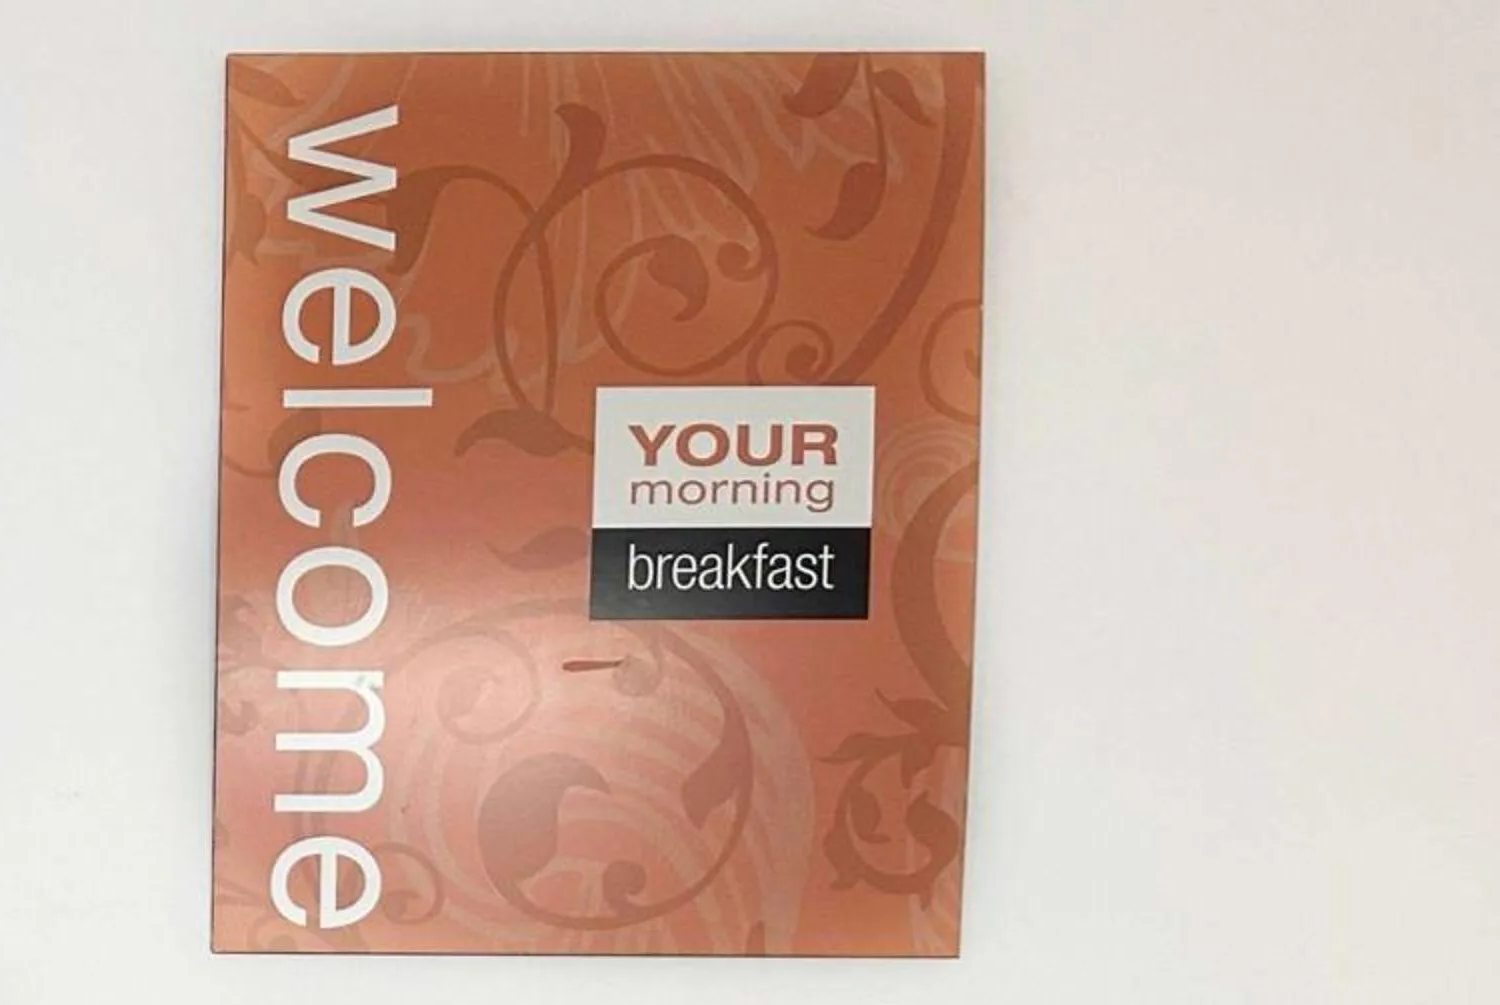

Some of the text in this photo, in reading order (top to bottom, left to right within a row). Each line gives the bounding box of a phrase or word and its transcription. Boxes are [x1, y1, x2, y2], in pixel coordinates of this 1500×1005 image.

[627, 423, 839, 467] YOUR
[629, 472, 835, 513] morning
[269, 104, 434, 930] welcome
[627, 542, 836, 591] breakfast
